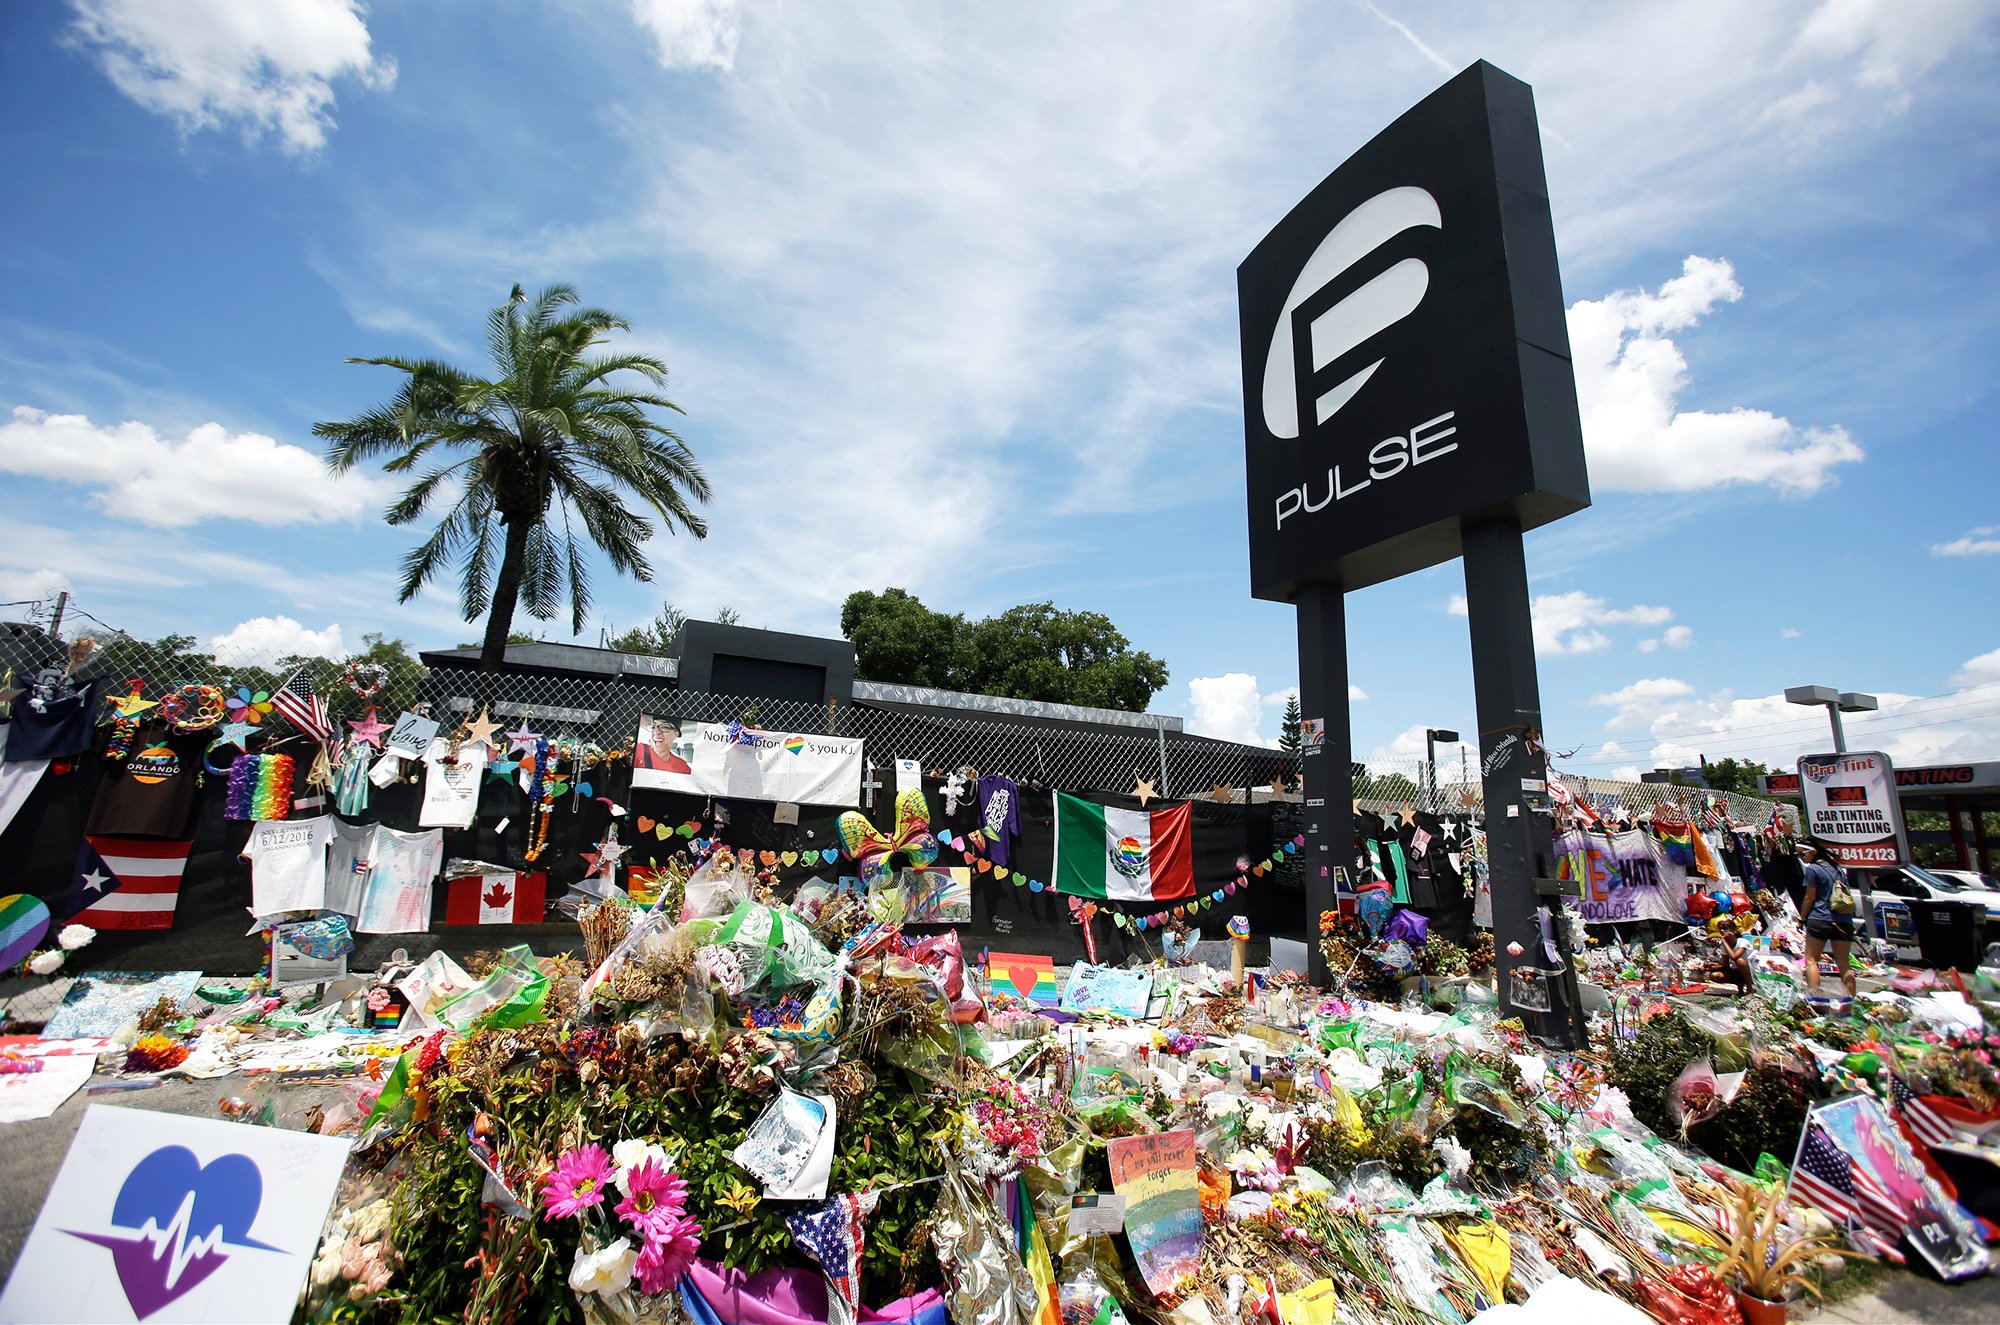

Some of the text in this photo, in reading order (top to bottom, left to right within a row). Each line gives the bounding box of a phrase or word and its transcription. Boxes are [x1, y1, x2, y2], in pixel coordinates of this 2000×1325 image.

[1275, 410, 1459, 532] PULSE
[817, 744, 838, 755] you
[1486, 750, 1498, 764] Bless
[1495, 734, 1518, 752] Orlando
[127, 763, 181, 774] ORLANDO
[1808, 757, 1876, 778] Pro Tint
[1771, 775, 1799, 788] 3M
[1894, 767, 1972, 785] INTING
[1832, 787, 1862, 800] 3M
[985, 805, 1007, 827] PACK
[1816, 809, 1883, 822] CAR TINTING
[1812, 822, 1891, 834] CAR DETAILING
[262, 830, 314, 847] 6/12/2016
[1618, 858, 1658, 887] HATE
[1072, 985, 1089, 998] LOVE
[1075, 993, 1092, 1005] PEACE
[1163, 1149, 1184, 1161] never
